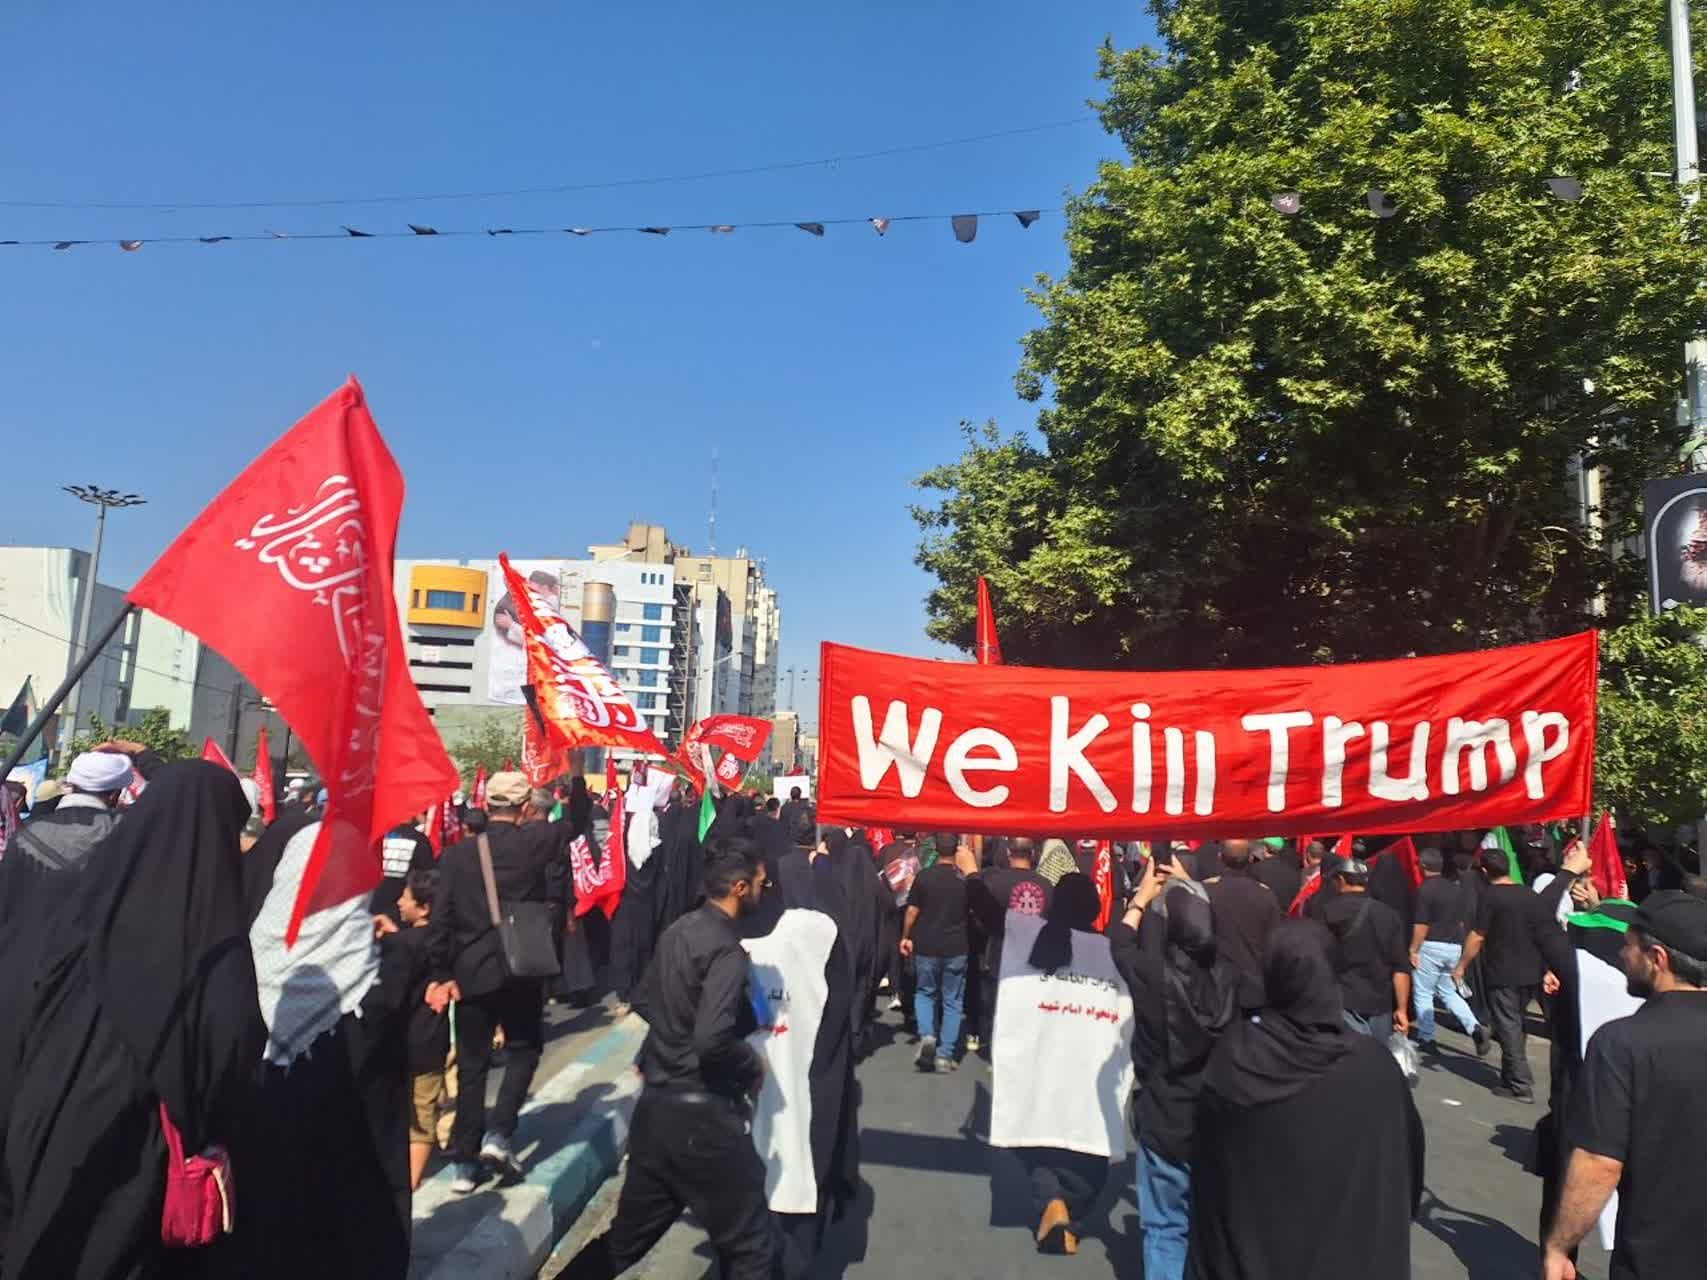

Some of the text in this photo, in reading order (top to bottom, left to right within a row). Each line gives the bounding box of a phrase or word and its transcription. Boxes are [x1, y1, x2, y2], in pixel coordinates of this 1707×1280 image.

[851, 694, 1570, 816] We Kill Trump
